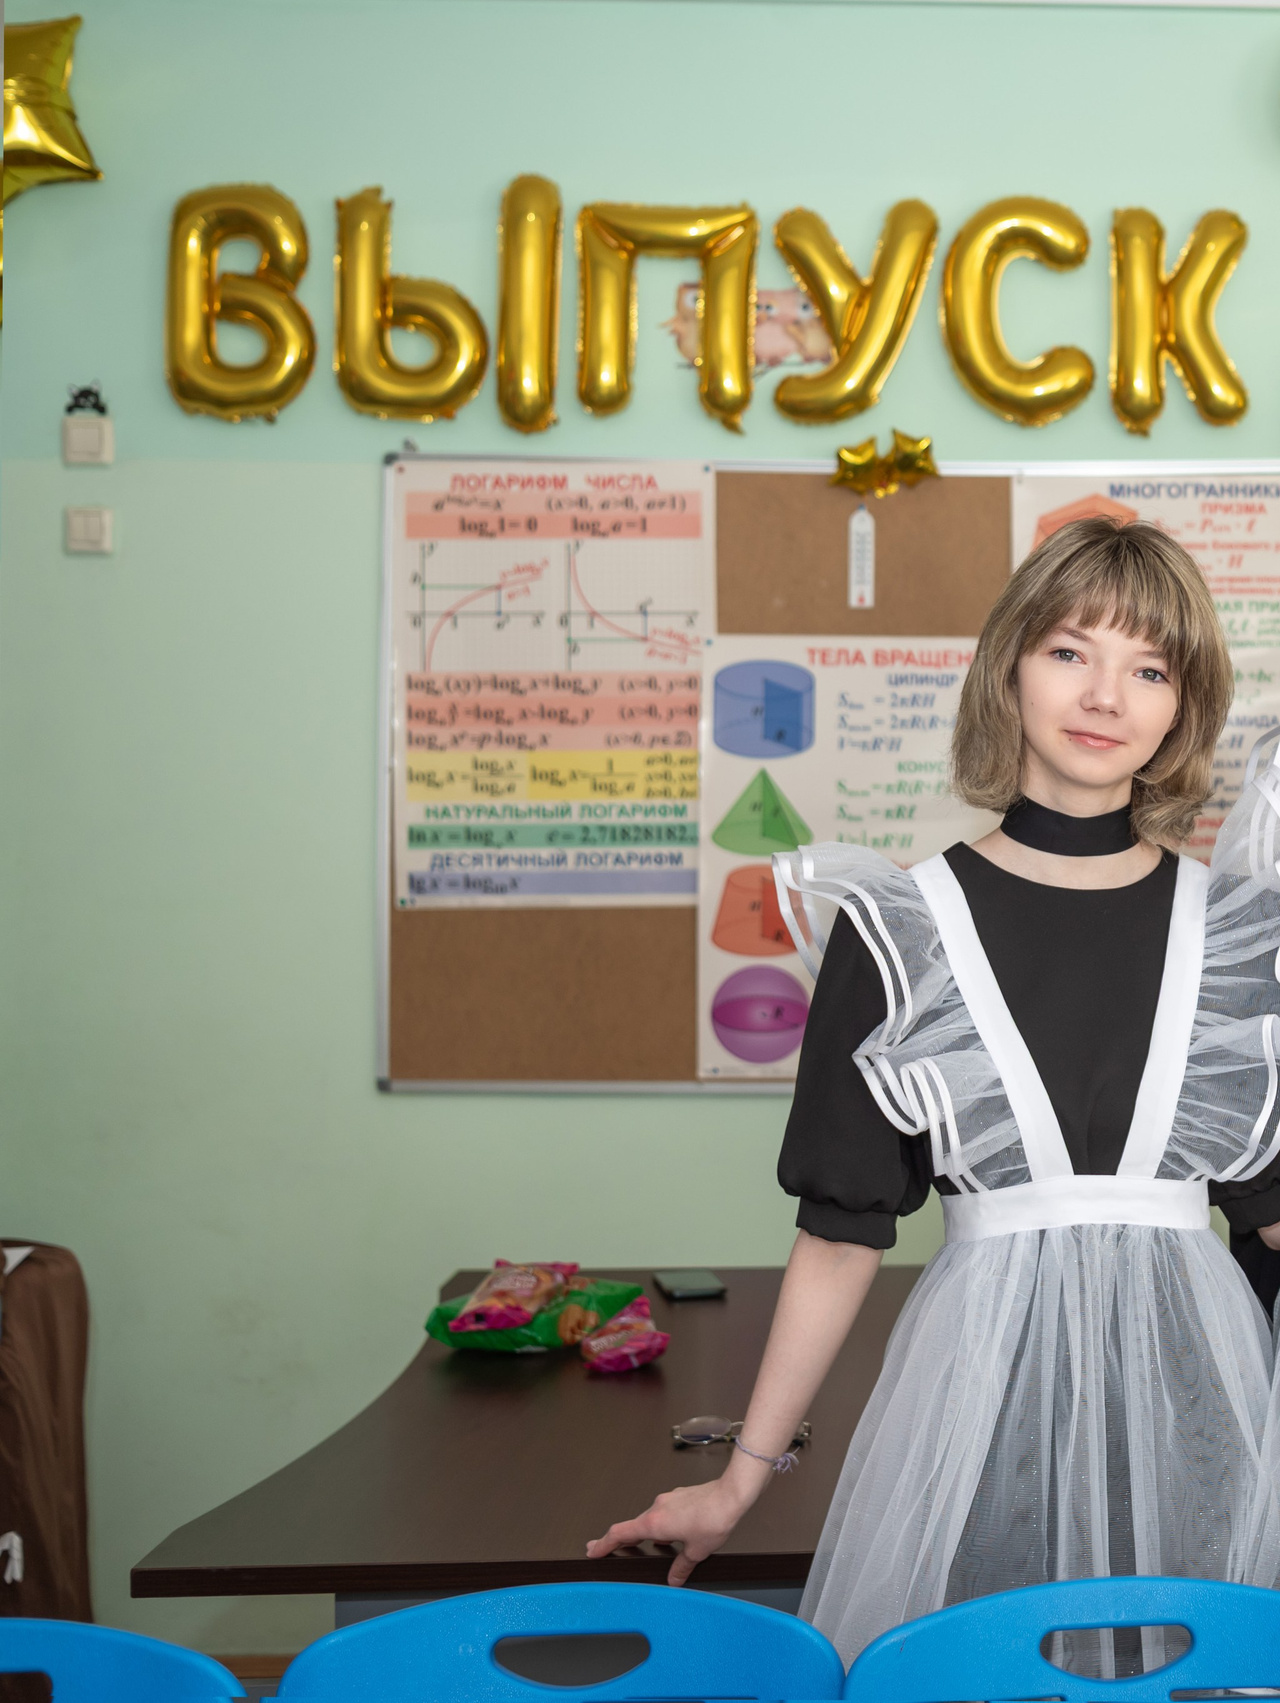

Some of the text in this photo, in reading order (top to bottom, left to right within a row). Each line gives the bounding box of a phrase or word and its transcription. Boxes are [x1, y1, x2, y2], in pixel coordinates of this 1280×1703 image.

[166, 172, 1249, 437] ВЫПУСК
[451, 473, 659, 491] ЛОГАРИФМ ЧИСЛА
[1201, 502, 1267, 515] ПРИЗМА
[806, 647, 974, 670] ТЕЛА ВРАЩЕН
[887, 673, 958, 689] ЦИЛИНДР
[897, 760, 946, 774] КОНУС
[425, 801, 688, 819] НАТУРАЛЬНЫЙ ЛОГАРИФМ
[430, 850, 684, 872] ДЕСЯТИЧНЫЙ ЛОГАРИФМ
